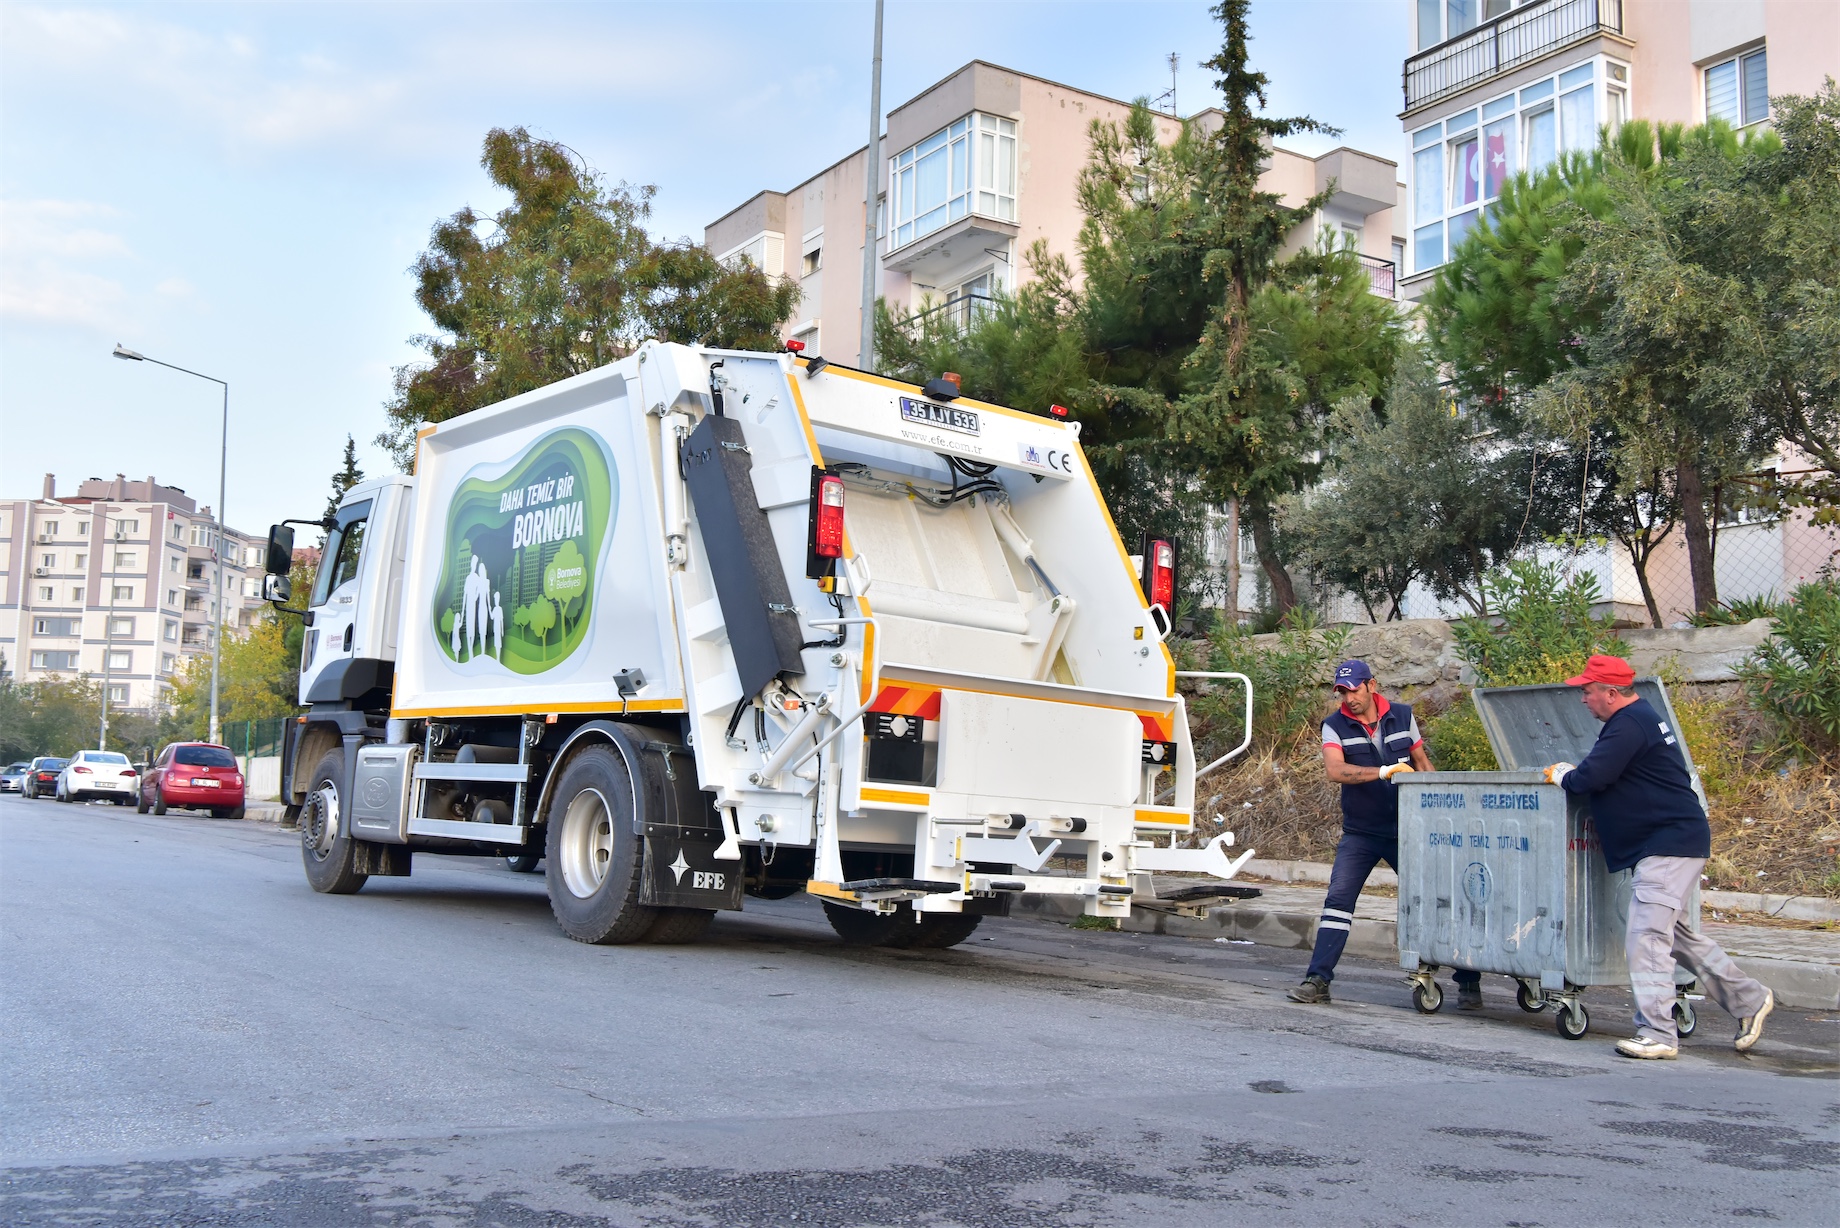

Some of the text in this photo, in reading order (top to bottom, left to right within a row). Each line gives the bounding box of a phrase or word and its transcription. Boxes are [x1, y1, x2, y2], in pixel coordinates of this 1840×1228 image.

[910, 402, 926, 418] 35
[929, 406, 951, 424] AJY
[953, 411, 977, 430] 533
[901, 429, 982, 454] www.efe.com.tr
[499, 472, 575, 513] DAHA TEMİZ BİR
[512, 501, 583, 549] BORNOVA
[1421, 791, 1540, 810] BORNOVA BELEDİYESİ
[692, 871, 725, 890] EFE
